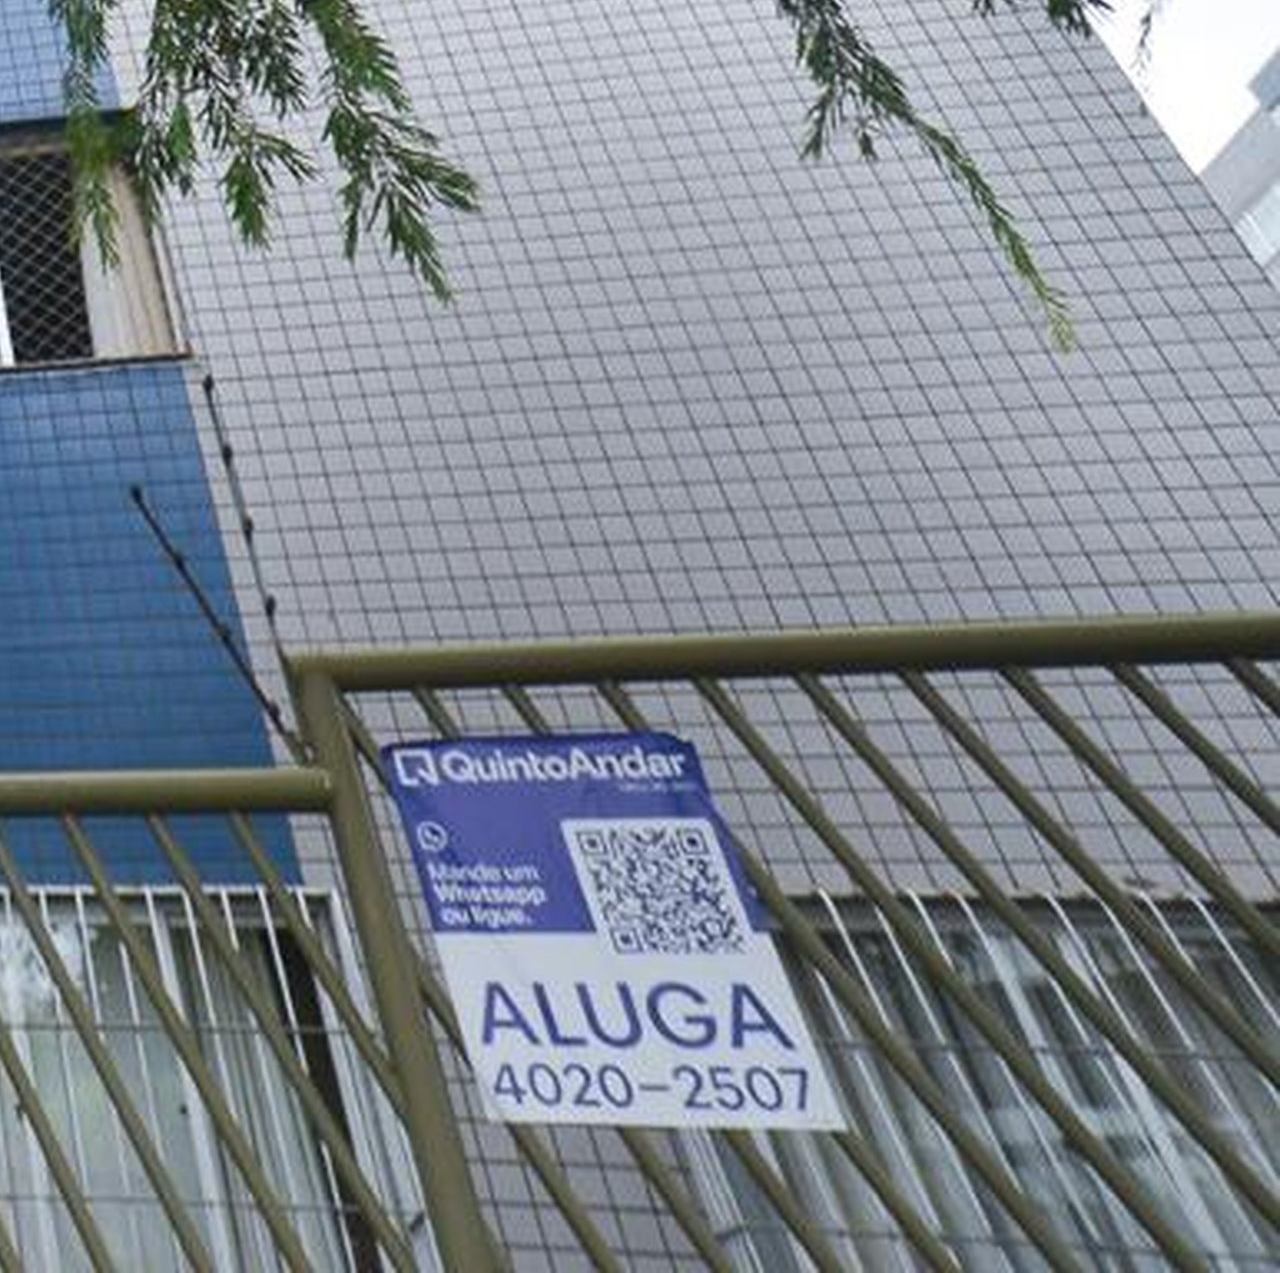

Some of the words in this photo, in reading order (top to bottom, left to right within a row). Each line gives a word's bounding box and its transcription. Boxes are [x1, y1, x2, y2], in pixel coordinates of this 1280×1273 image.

[440, 746, 686, 784] QuintoAndar
[441, 907, 469, 925] ou
[482, 982, 795, 1050] ALUGA
[493, 1063, 809, 1112] 4020-2507
